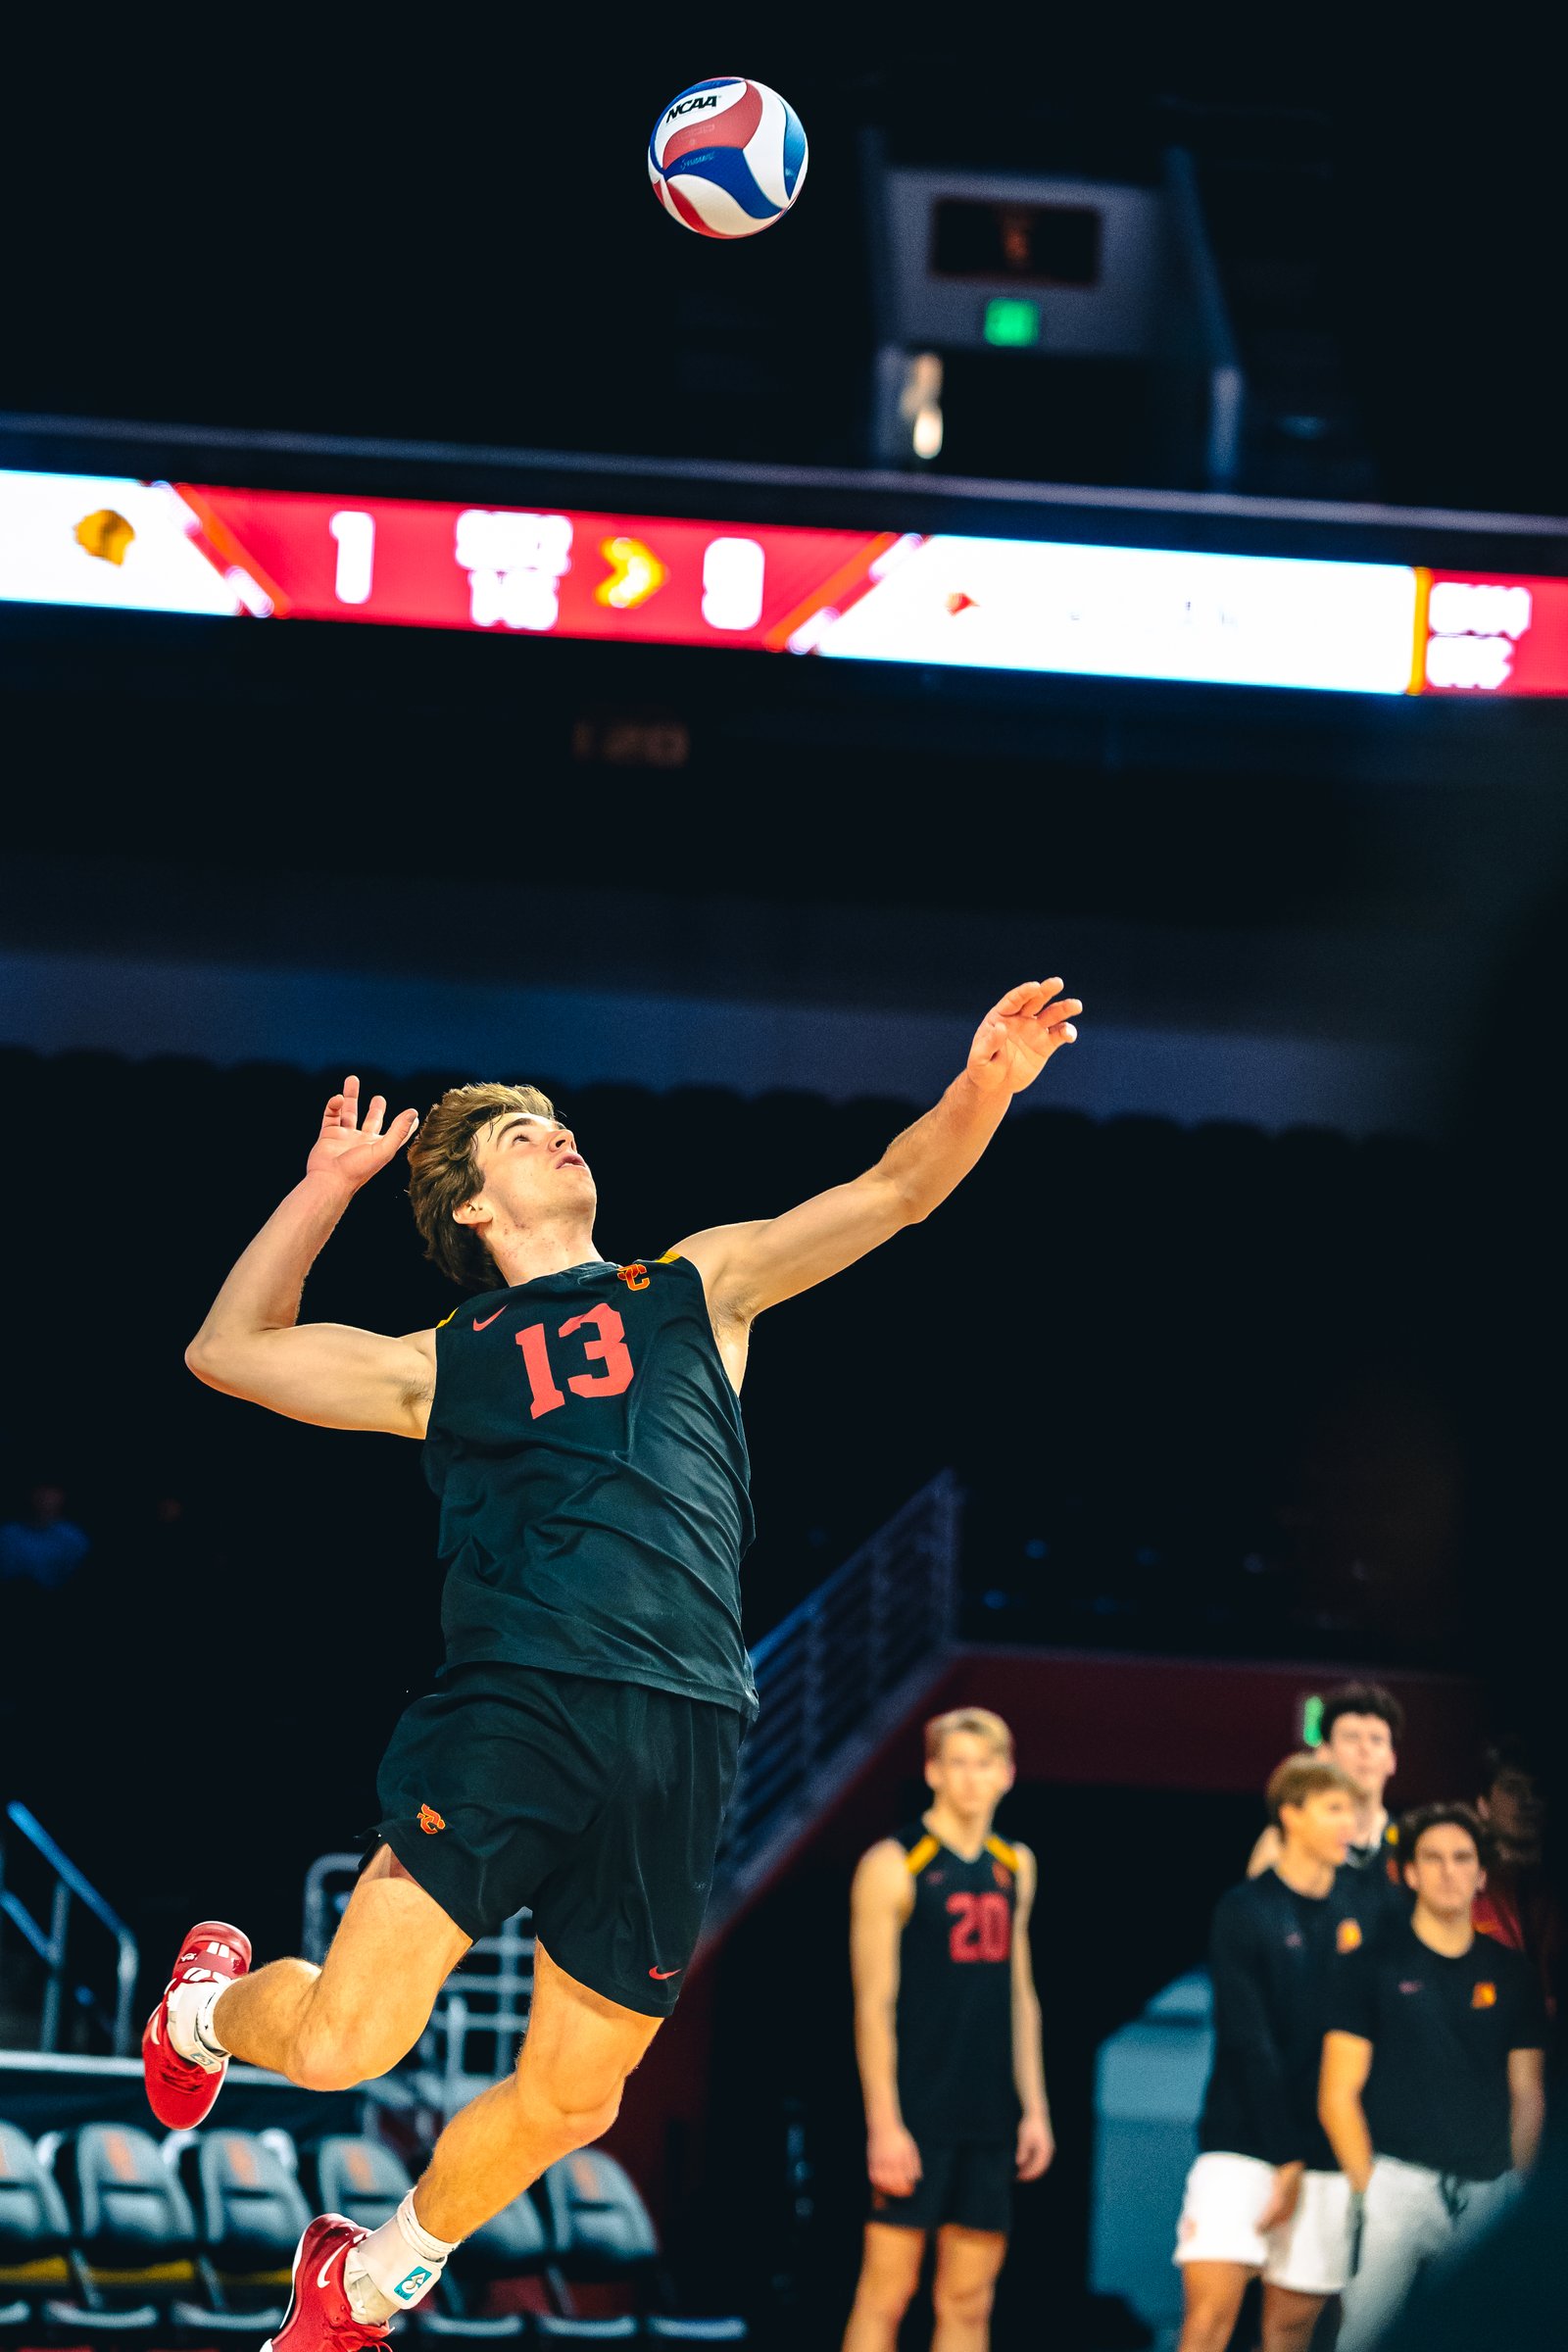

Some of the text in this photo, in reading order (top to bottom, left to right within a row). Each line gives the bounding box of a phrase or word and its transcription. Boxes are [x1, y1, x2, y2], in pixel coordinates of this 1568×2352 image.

[666, 95, 717, 123] NCAA
[515, 1302, 634, 1419] 13
[946, 1891, 1009, 1963] 20
